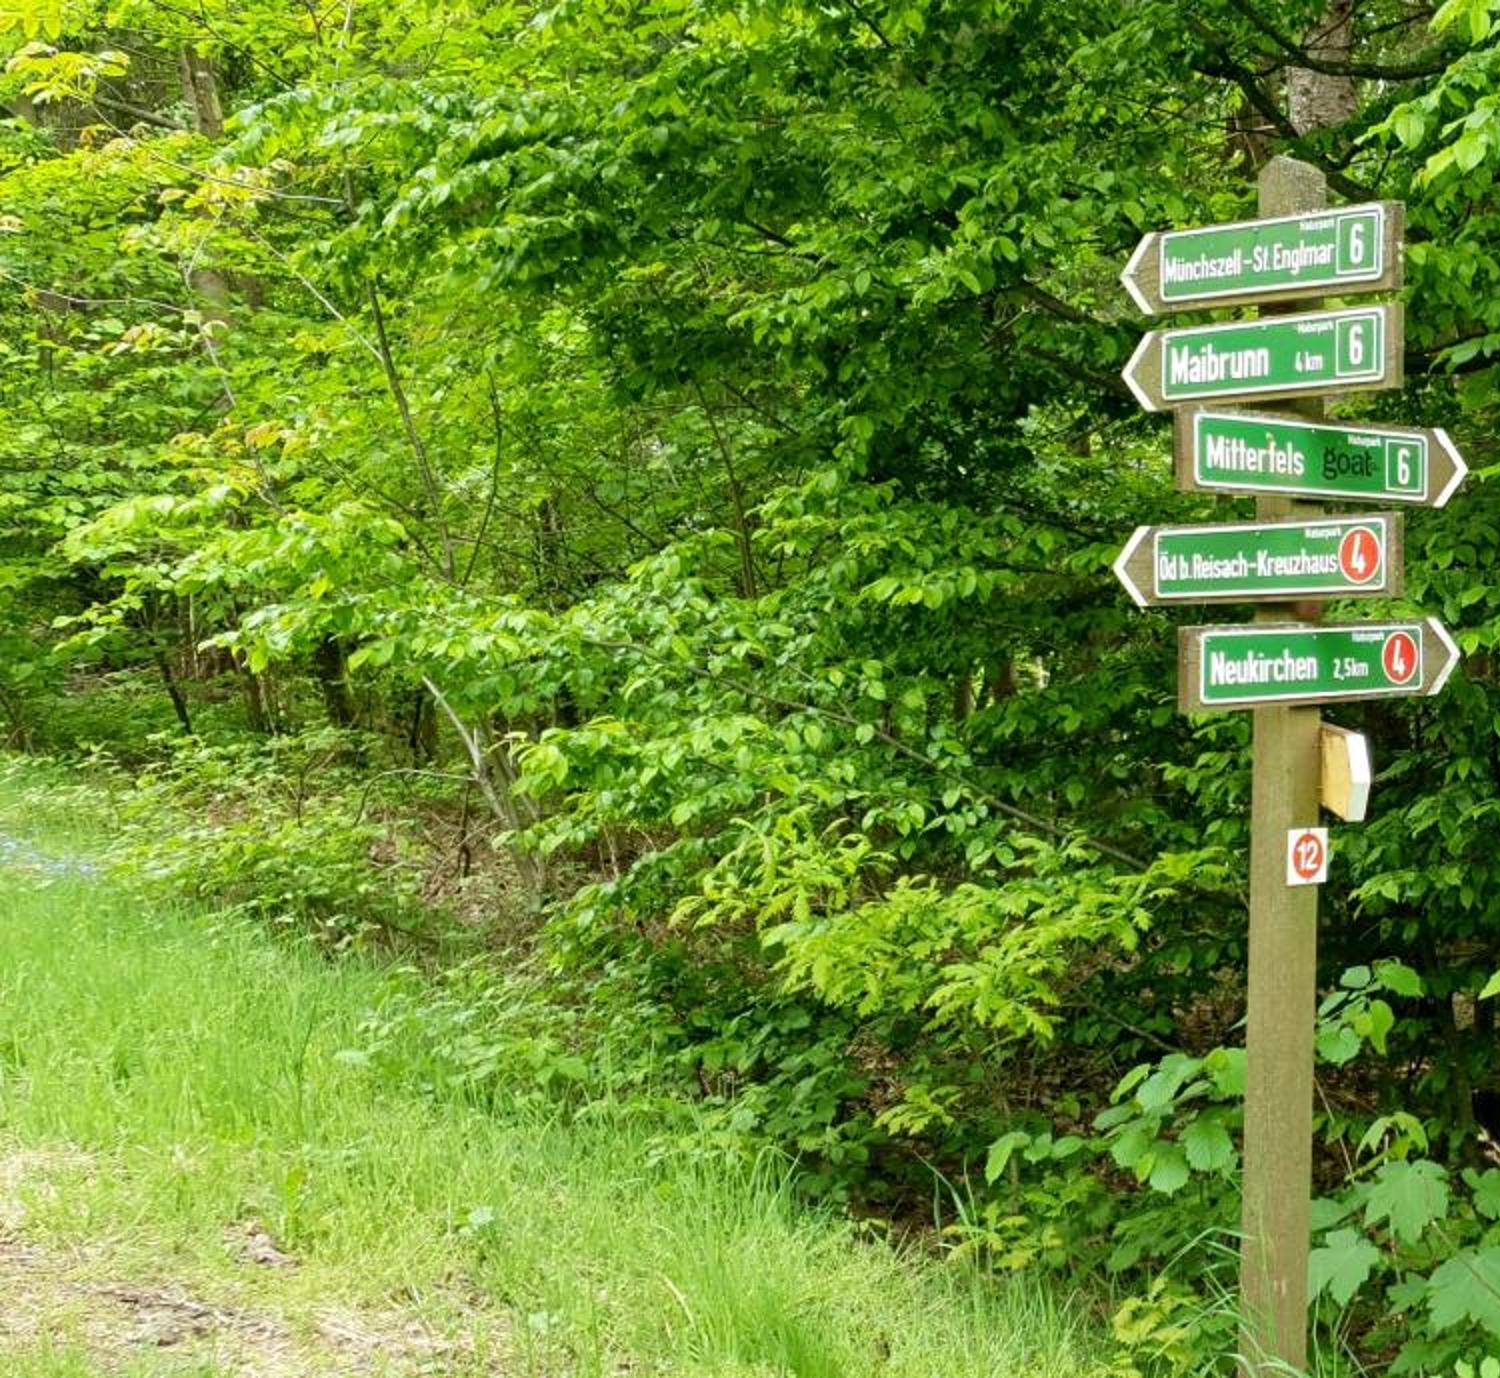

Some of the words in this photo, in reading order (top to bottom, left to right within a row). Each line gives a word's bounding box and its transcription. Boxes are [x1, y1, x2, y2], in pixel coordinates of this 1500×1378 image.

[1273, 239, 1335, 276] Englmar
[1349, 223, 1364, 265] 6
[1349, 325, 1363, 365] 6
[1171, 346, 1269, 385] Maibrunn
[1294, 352, 1304, 373] 4
[1305, 351, 1323, 370] km
[1205, 433, 1305, 477] Mitterfels
[1322, 447, 1373, 481] goat
[1397, 448, 1410, 485] 6
[1159, 551, 1177, 581] Öd
[1351, 533, 1367, 573] 4
[1210, 647, 1318, 686] Neukirchen
[1392, 638, 1406, 677] 4
[1297, 841, 1319, 871] 12
